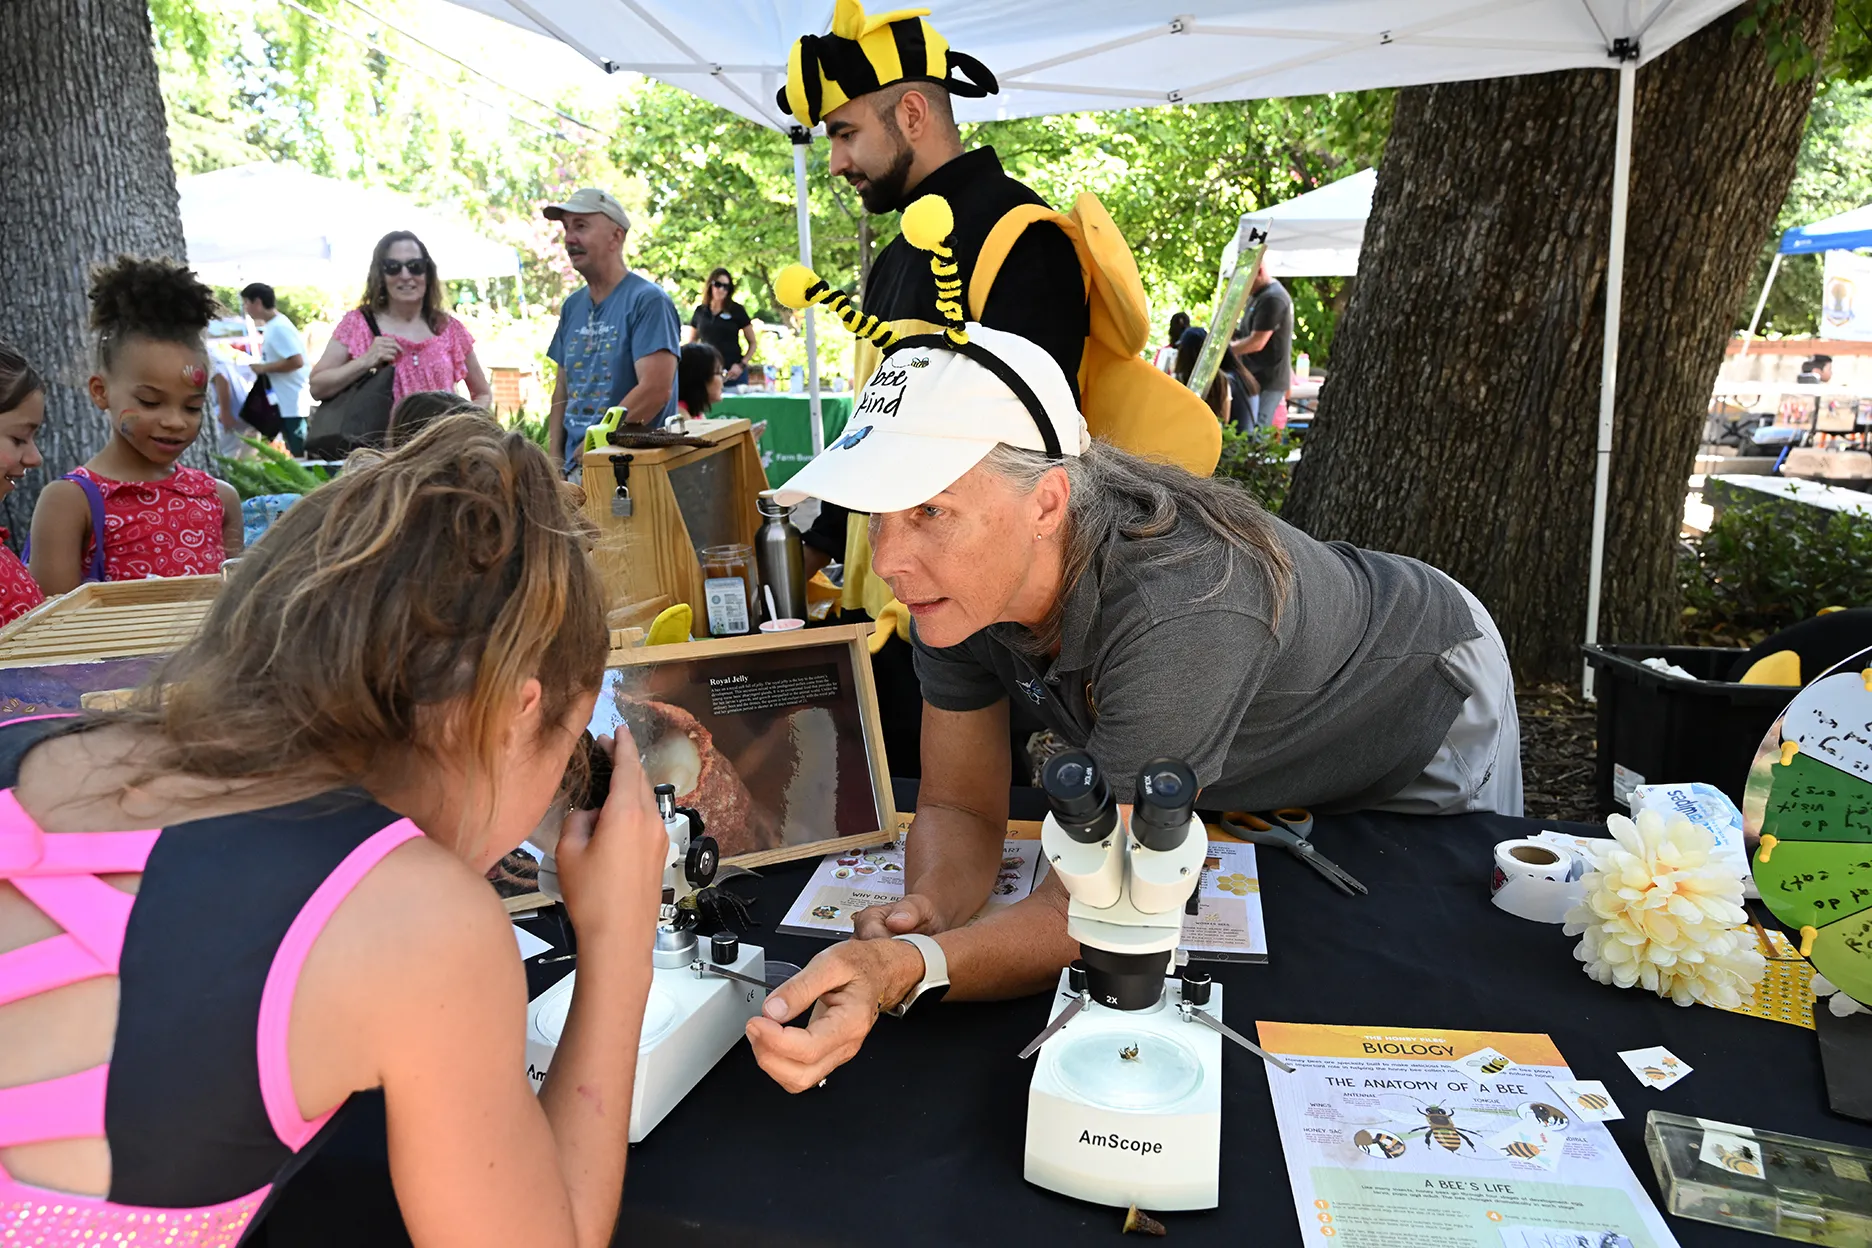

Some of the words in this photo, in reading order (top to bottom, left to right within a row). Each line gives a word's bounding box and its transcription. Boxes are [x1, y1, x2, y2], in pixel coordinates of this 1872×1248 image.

[869, 366, 908, 387] bee
[853, 385, 907, 418] kind
[776, 453, 796, 461] Farm
[710, 677, 731, 686] Royal
[732, 675, 749, 683] Jelly
[1776, 801, 1824, 814] visit
[1801, 820, 1829, 833] do
[1812, 898, 1841, 911] do
[1106, 995, 1119, 1005] 2X
[1363, 1043, 1454, 1057] BIOLOGY
[1325, 1077, 1356, 1088] THE
[1364, 1079, 1438, 1091] ANATOMY
[1447, 1082, 1469, 1092] OF
[1479, 1084, 1490, 1093] A
[1496, 1084, 1529, 1095] BEE
[1078, 1130, 1163, 1156] AmScope
[1424, 1179, 1434, 1188] A
[1439, 1180, 1480, 1191] BEE'S
[1483, 1183, 1515, 1194] LIFE
